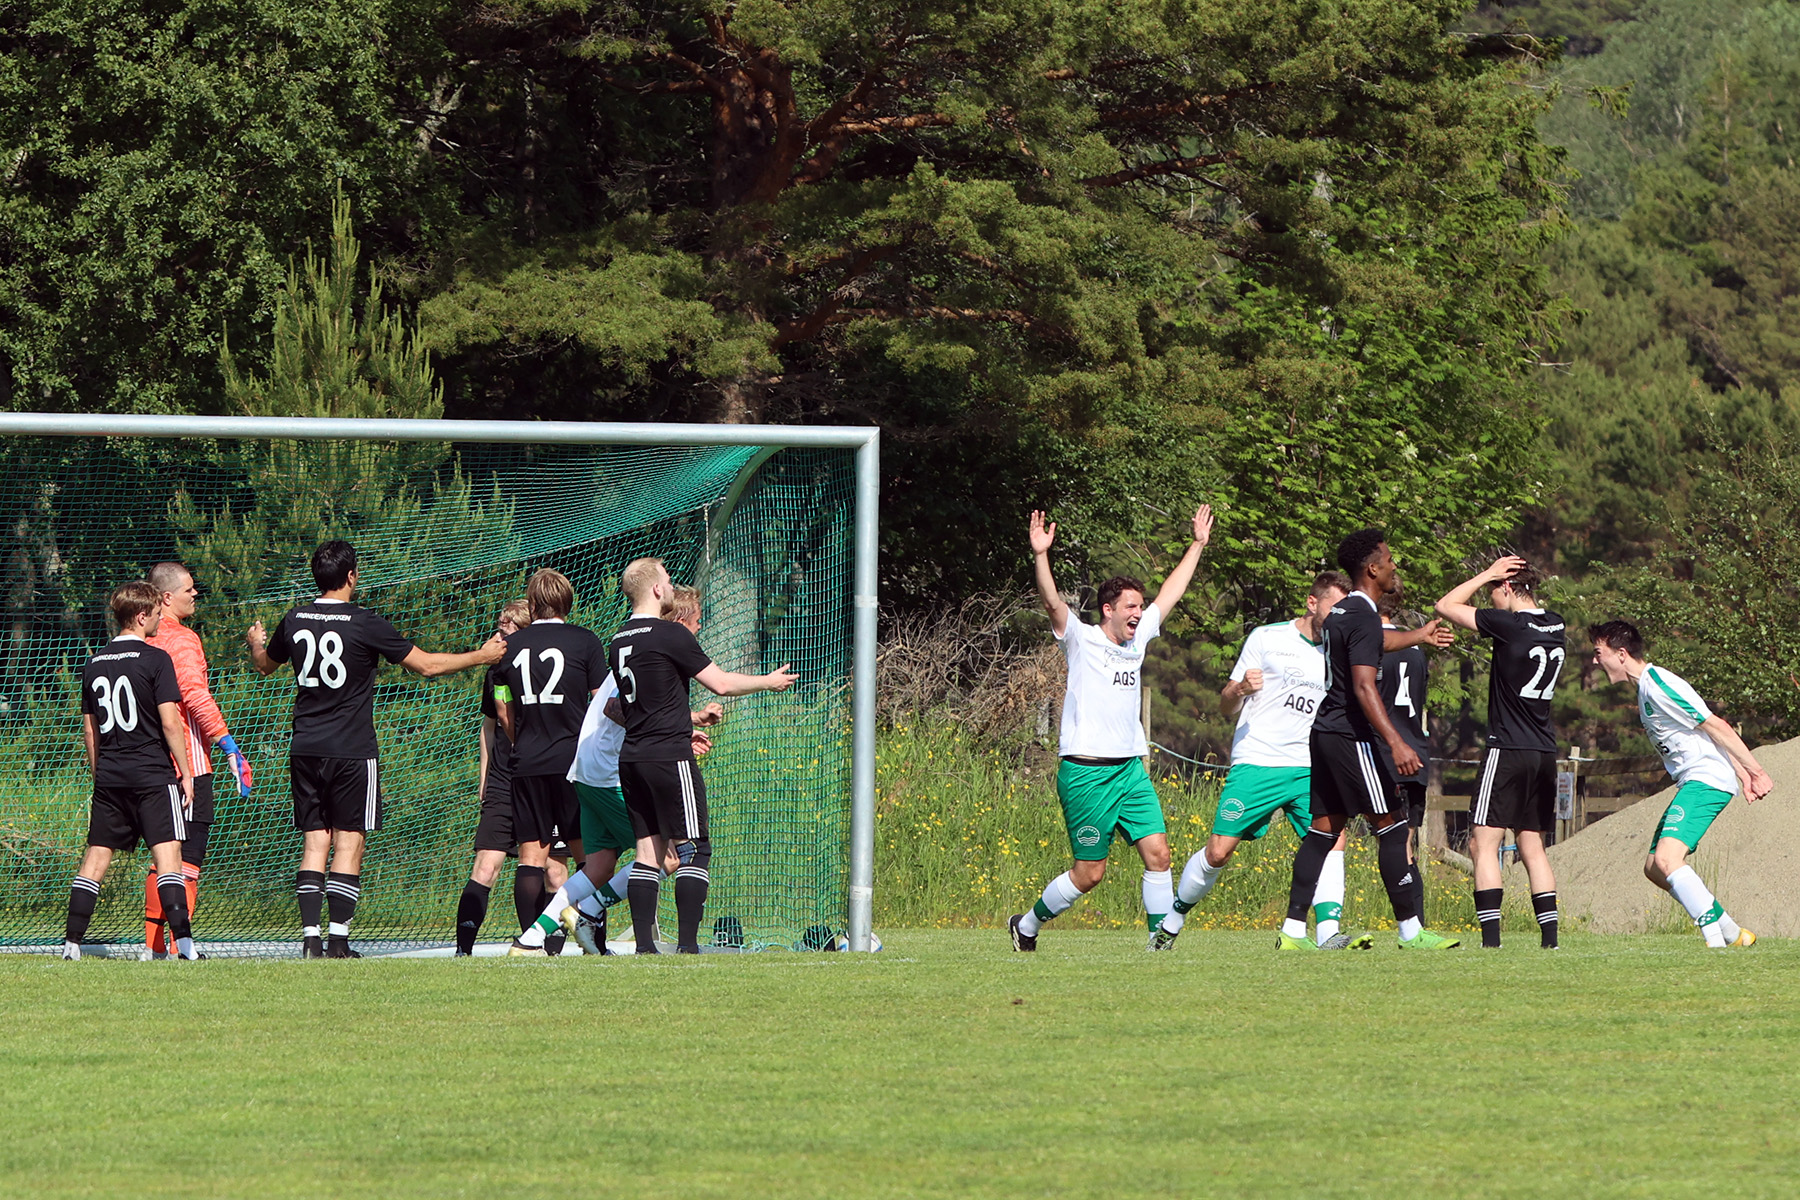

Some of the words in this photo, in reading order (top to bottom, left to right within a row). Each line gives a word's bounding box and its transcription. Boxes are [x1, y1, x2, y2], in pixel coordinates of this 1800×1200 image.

[292, 629, 347, 689] 28
[512, 647, 564, 705] 12
[618, 645, 637, 703] 5
[1112, 671, 1136, 686] AQS
[1520, 646, 1565, 700] 22
[91, 674, 138, 734] 30
[1283, 693, 1315, 714] AQS
[1394, 662, 1416, 718] 4
